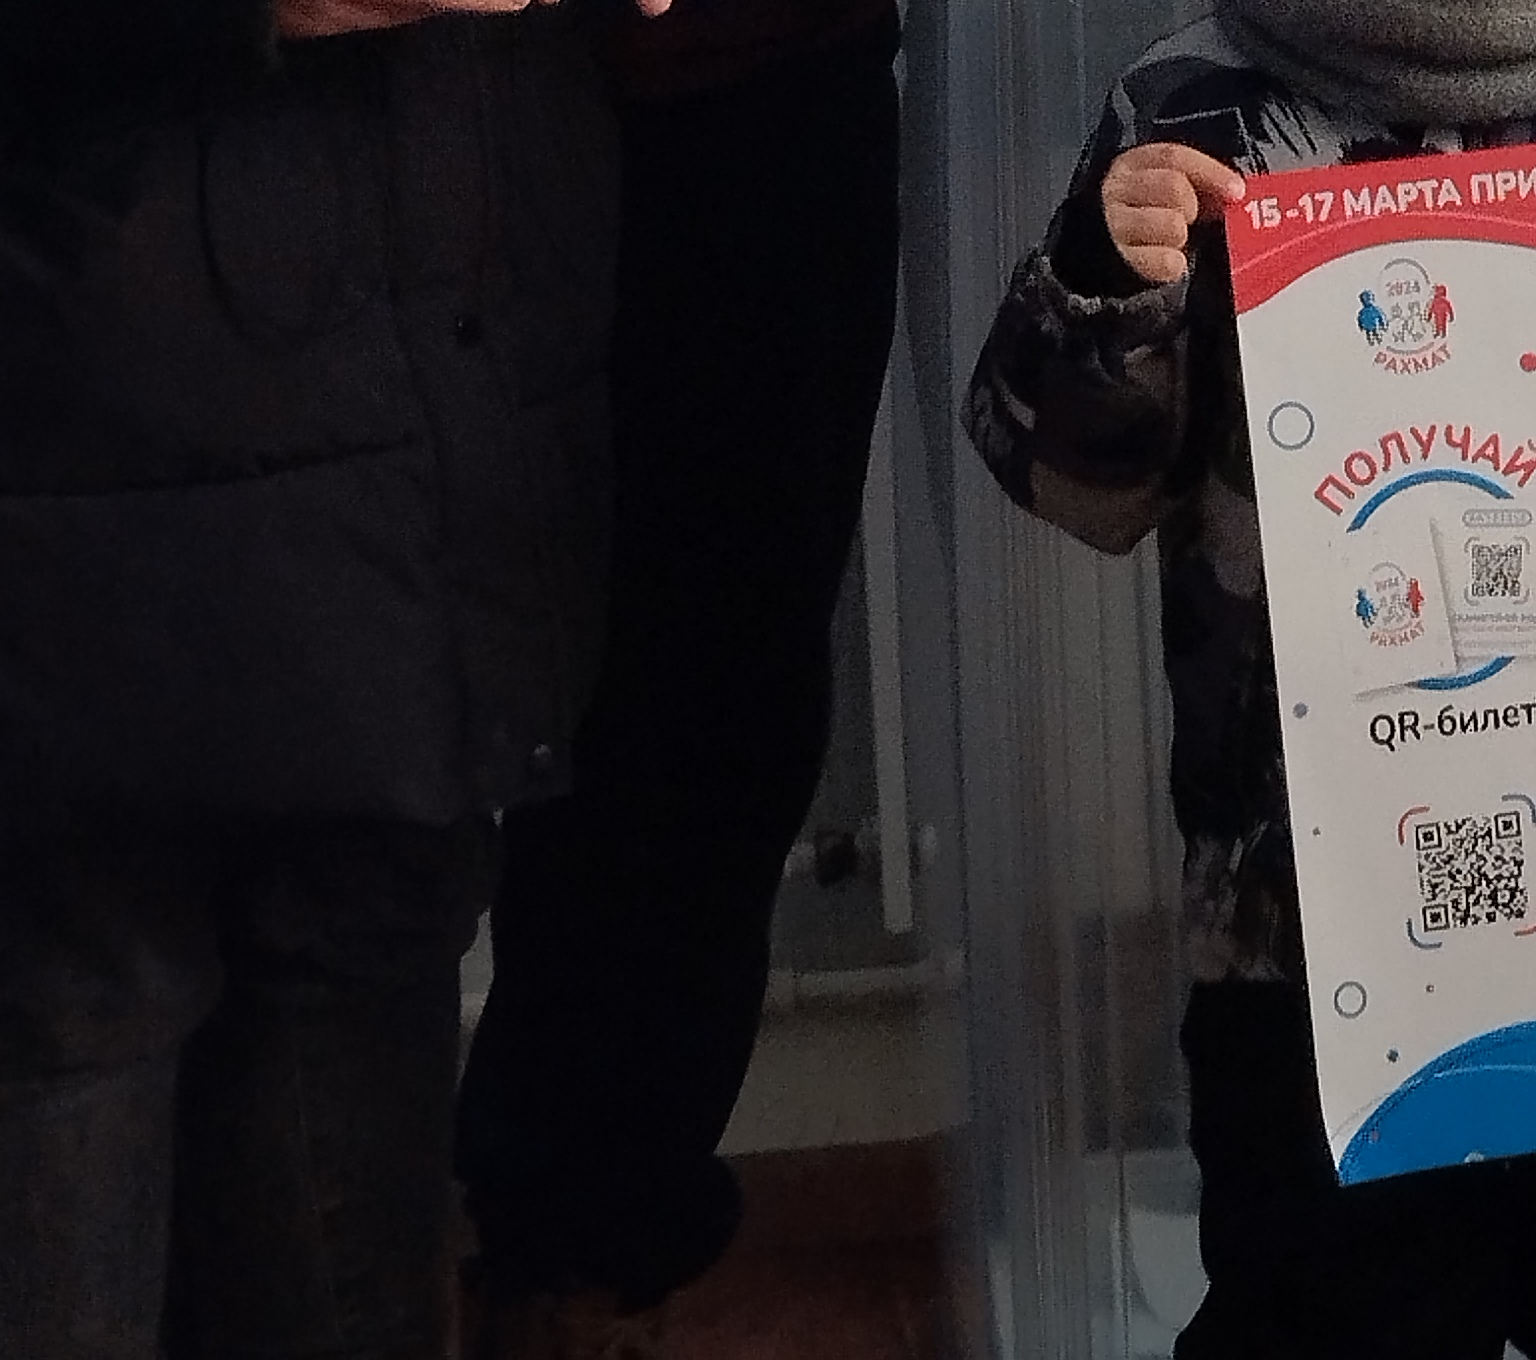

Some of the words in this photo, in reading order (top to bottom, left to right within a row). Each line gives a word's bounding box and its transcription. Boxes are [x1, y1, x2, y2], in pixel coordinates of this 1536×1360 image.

[1244, 191, 1334, 230] 15-17
[1342, 178, 1462, 218] МАРТА
[1373, 342, 1450, 374] РАХМАТ
